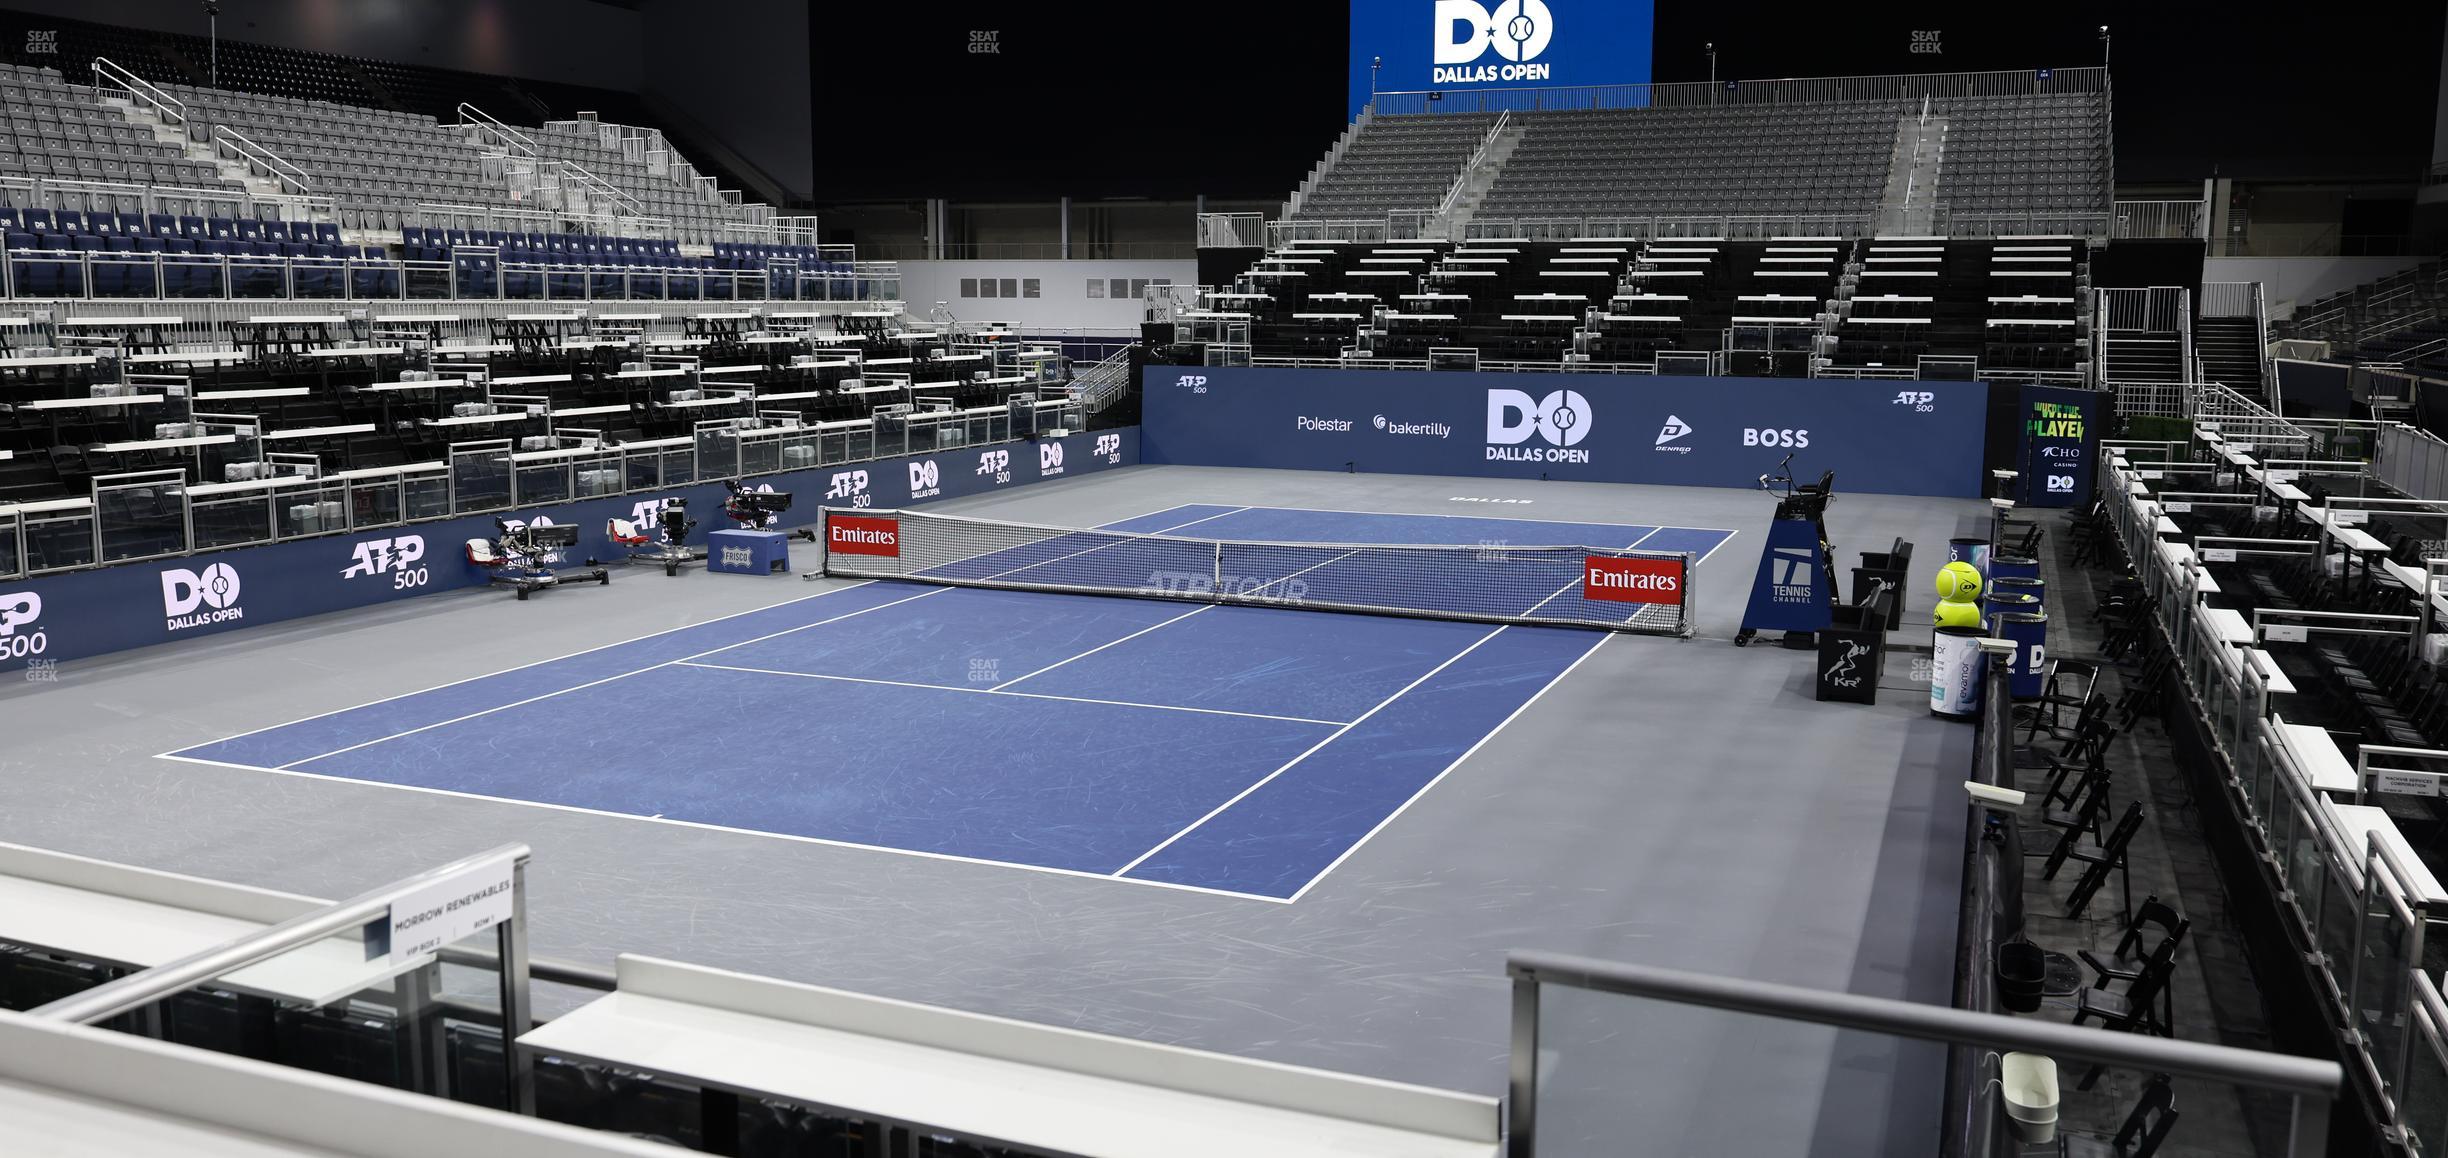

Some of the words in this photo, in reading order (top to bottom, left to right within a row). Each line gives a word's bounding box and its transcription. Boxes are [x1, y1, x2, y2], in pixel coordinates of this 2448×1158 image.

[1433, 65, 1499, 84] DALLAS
[1501, 62, 1550, 81] OPEN
[1176, 375, 1207, 388] ATP
[1892, 391, 1935, 406] ATP
[1486, 389, 1593, 445] DO
[1915, 404, 1935, 413] 500
[1297, 415, 1353, 432] Polestar
[1389, 421, 1451, 439] bakertilly
[1093, 433, 1120, 456] ATP
[1743, 428, 1809, 449] BOSS
[976, 449, 1009, 476] ATP
[1109, 452, 1120, 464] 500
[1485, 446, 1544, 462] DALLAS
[1546, 447, 1590, 464] OPEN
[996, 470, 1010, 484] 500
[1041, 466, 1054, 475] DALLAS
[1054, 465, 1064, 474] OPEN
[824, 469, 869, 500] ATP
[911, 489, 928, 499] DALLAS
[928, 487, 940, 496] OPEN
[852, 493, 871, 509] 500
[1449, 496, 1534, 505] DALLAS
[831, 525, 895, 546] Emirates
[338, 534, 425, 579] ATP
[725, 550, 749, 562] FRISCO
[393, 567, 429, 590] 500
[1137, 570, 1213, 598] ATP
[1590, 567, 1677, 591] Emirates
[1773, 585, 1811, 598] TENNIS
[1773, 596, 1812, 604] CHANNEL
[167, 612, 211, 631] DALLAS
[212, 607, 243, 623] OPEN
[1960, 662, 1969, 698] evamor
[394, 905, 444, 933] MORROW
[446, 879, 510, 913] RENEWABLES
[473, 918, 489, 929] ROW
[420, 941, 434, 951] BOX
